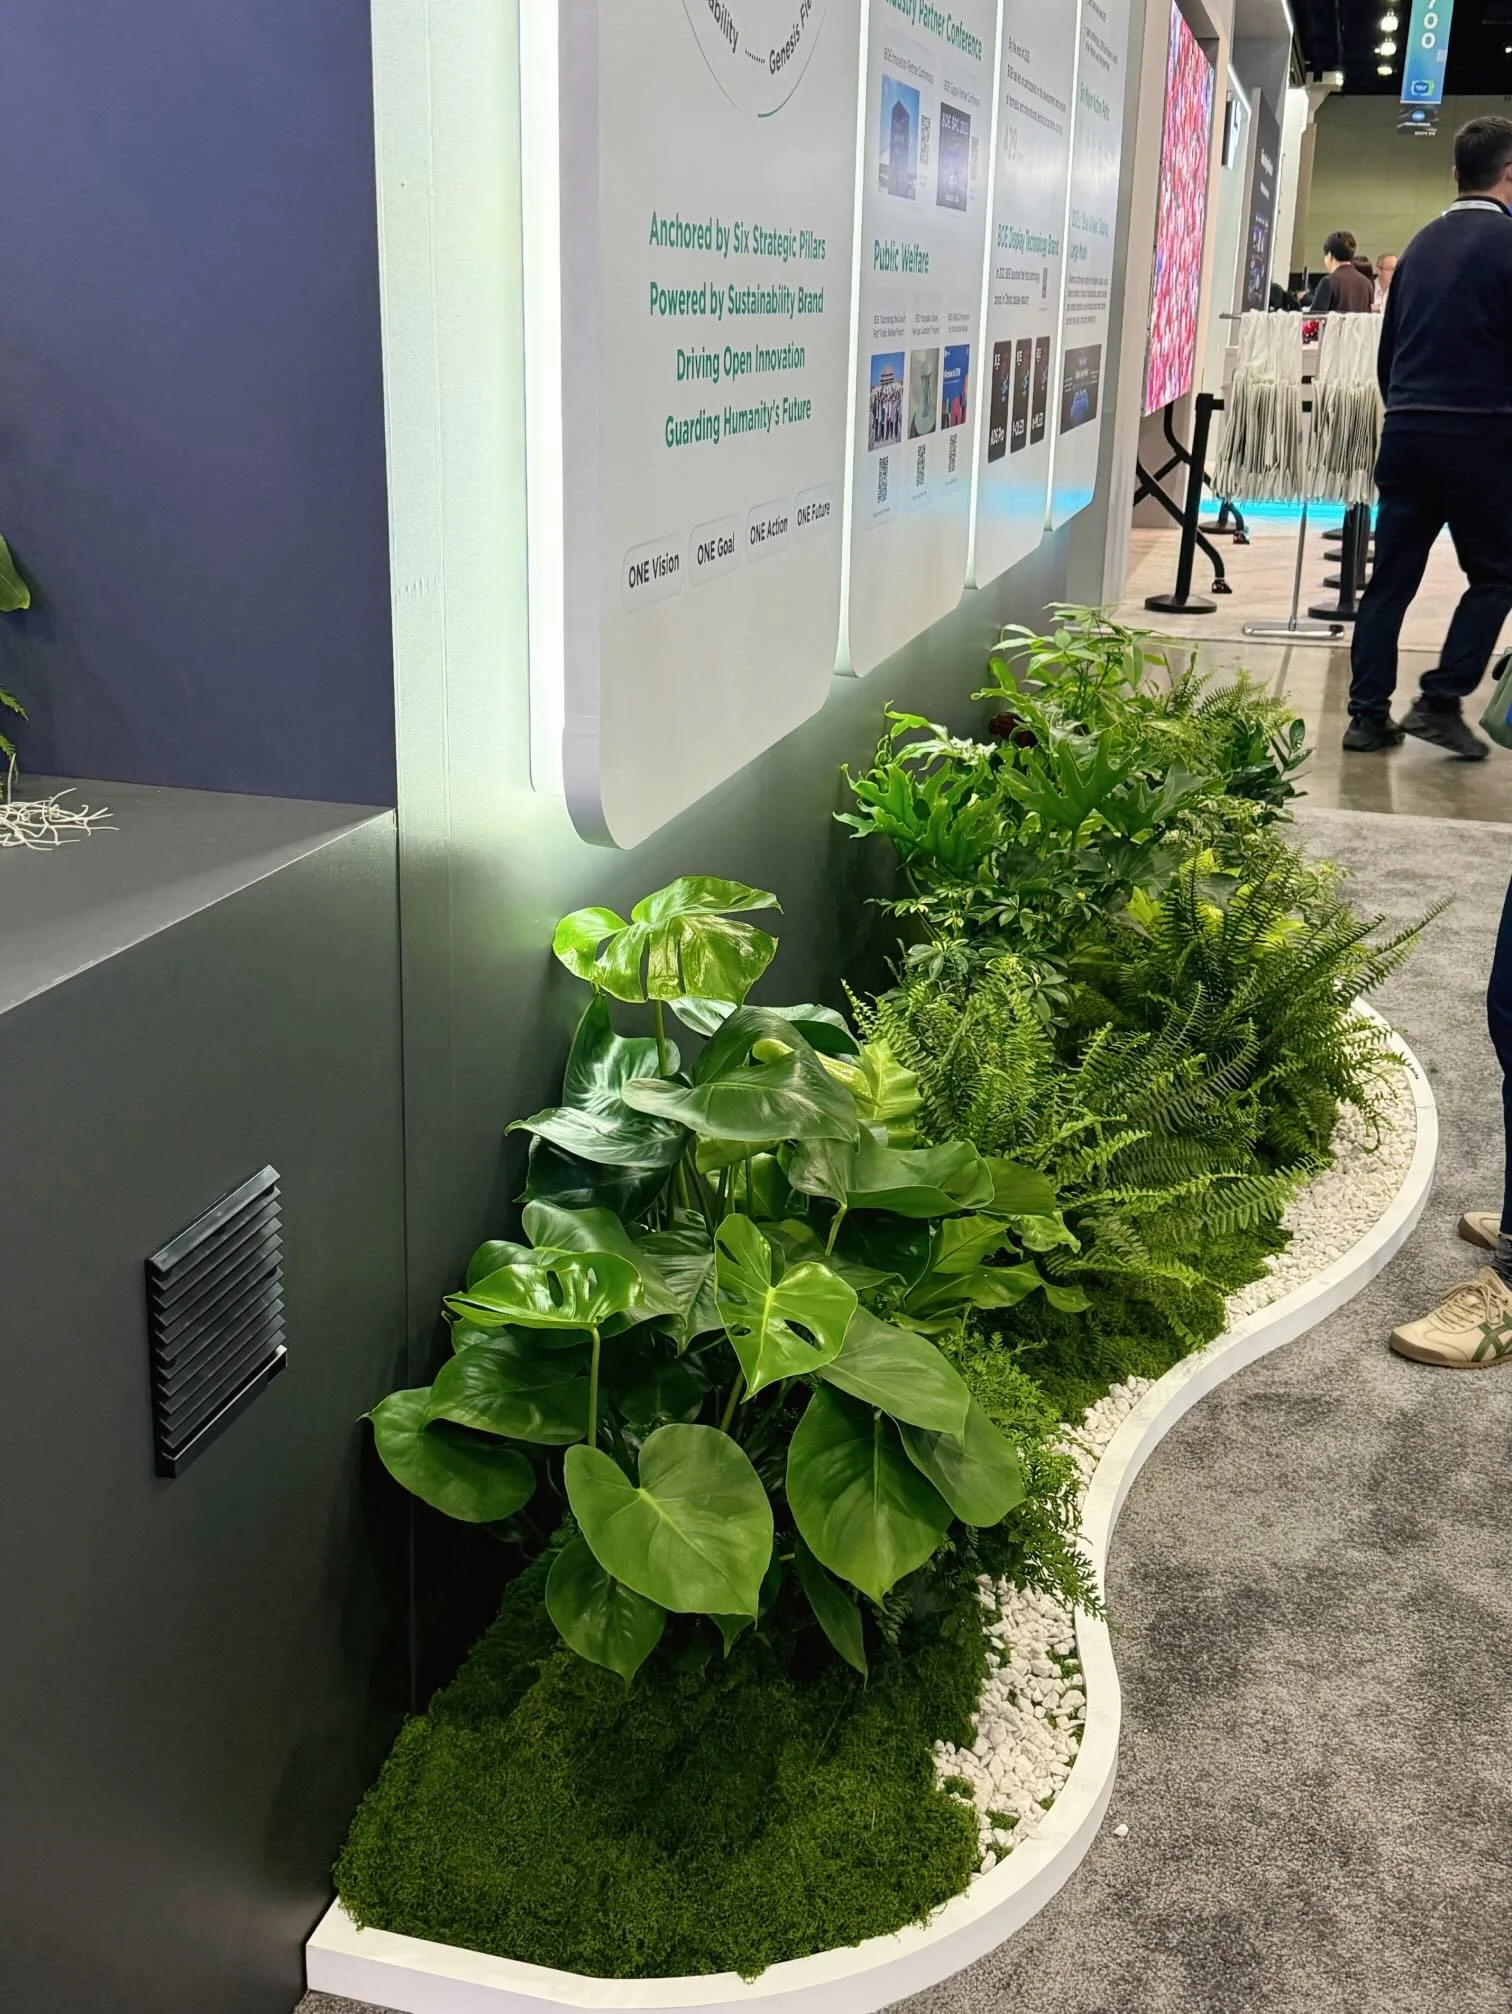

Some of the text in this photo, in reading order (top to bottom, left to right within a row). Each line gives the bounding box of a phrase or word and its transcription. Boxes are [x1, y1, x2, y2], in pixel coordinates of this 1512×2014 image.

[769, 23, 801, 75] Genesis
[918, 0, 945, 37] Partner
[946, 13, 982, 61] Conference
[649, 210, 826, 263] Anchored by Six Strategic Pillars
[873, 240, 929, 274] Public Welfare
[650, 281, 824, 321] Powered by Sustainability Brand
[676, 341, 805, 384] Driving Open Innovation
[665, 396, 812, 448] Guarding Humanity's Future
[750, 516, 788, 545] ONE Action
[797, 499, 831, 527] ONE Future
[697, 532, 735, 566] ONE Goal
[628, 552, 680, 589] ONE Vision
